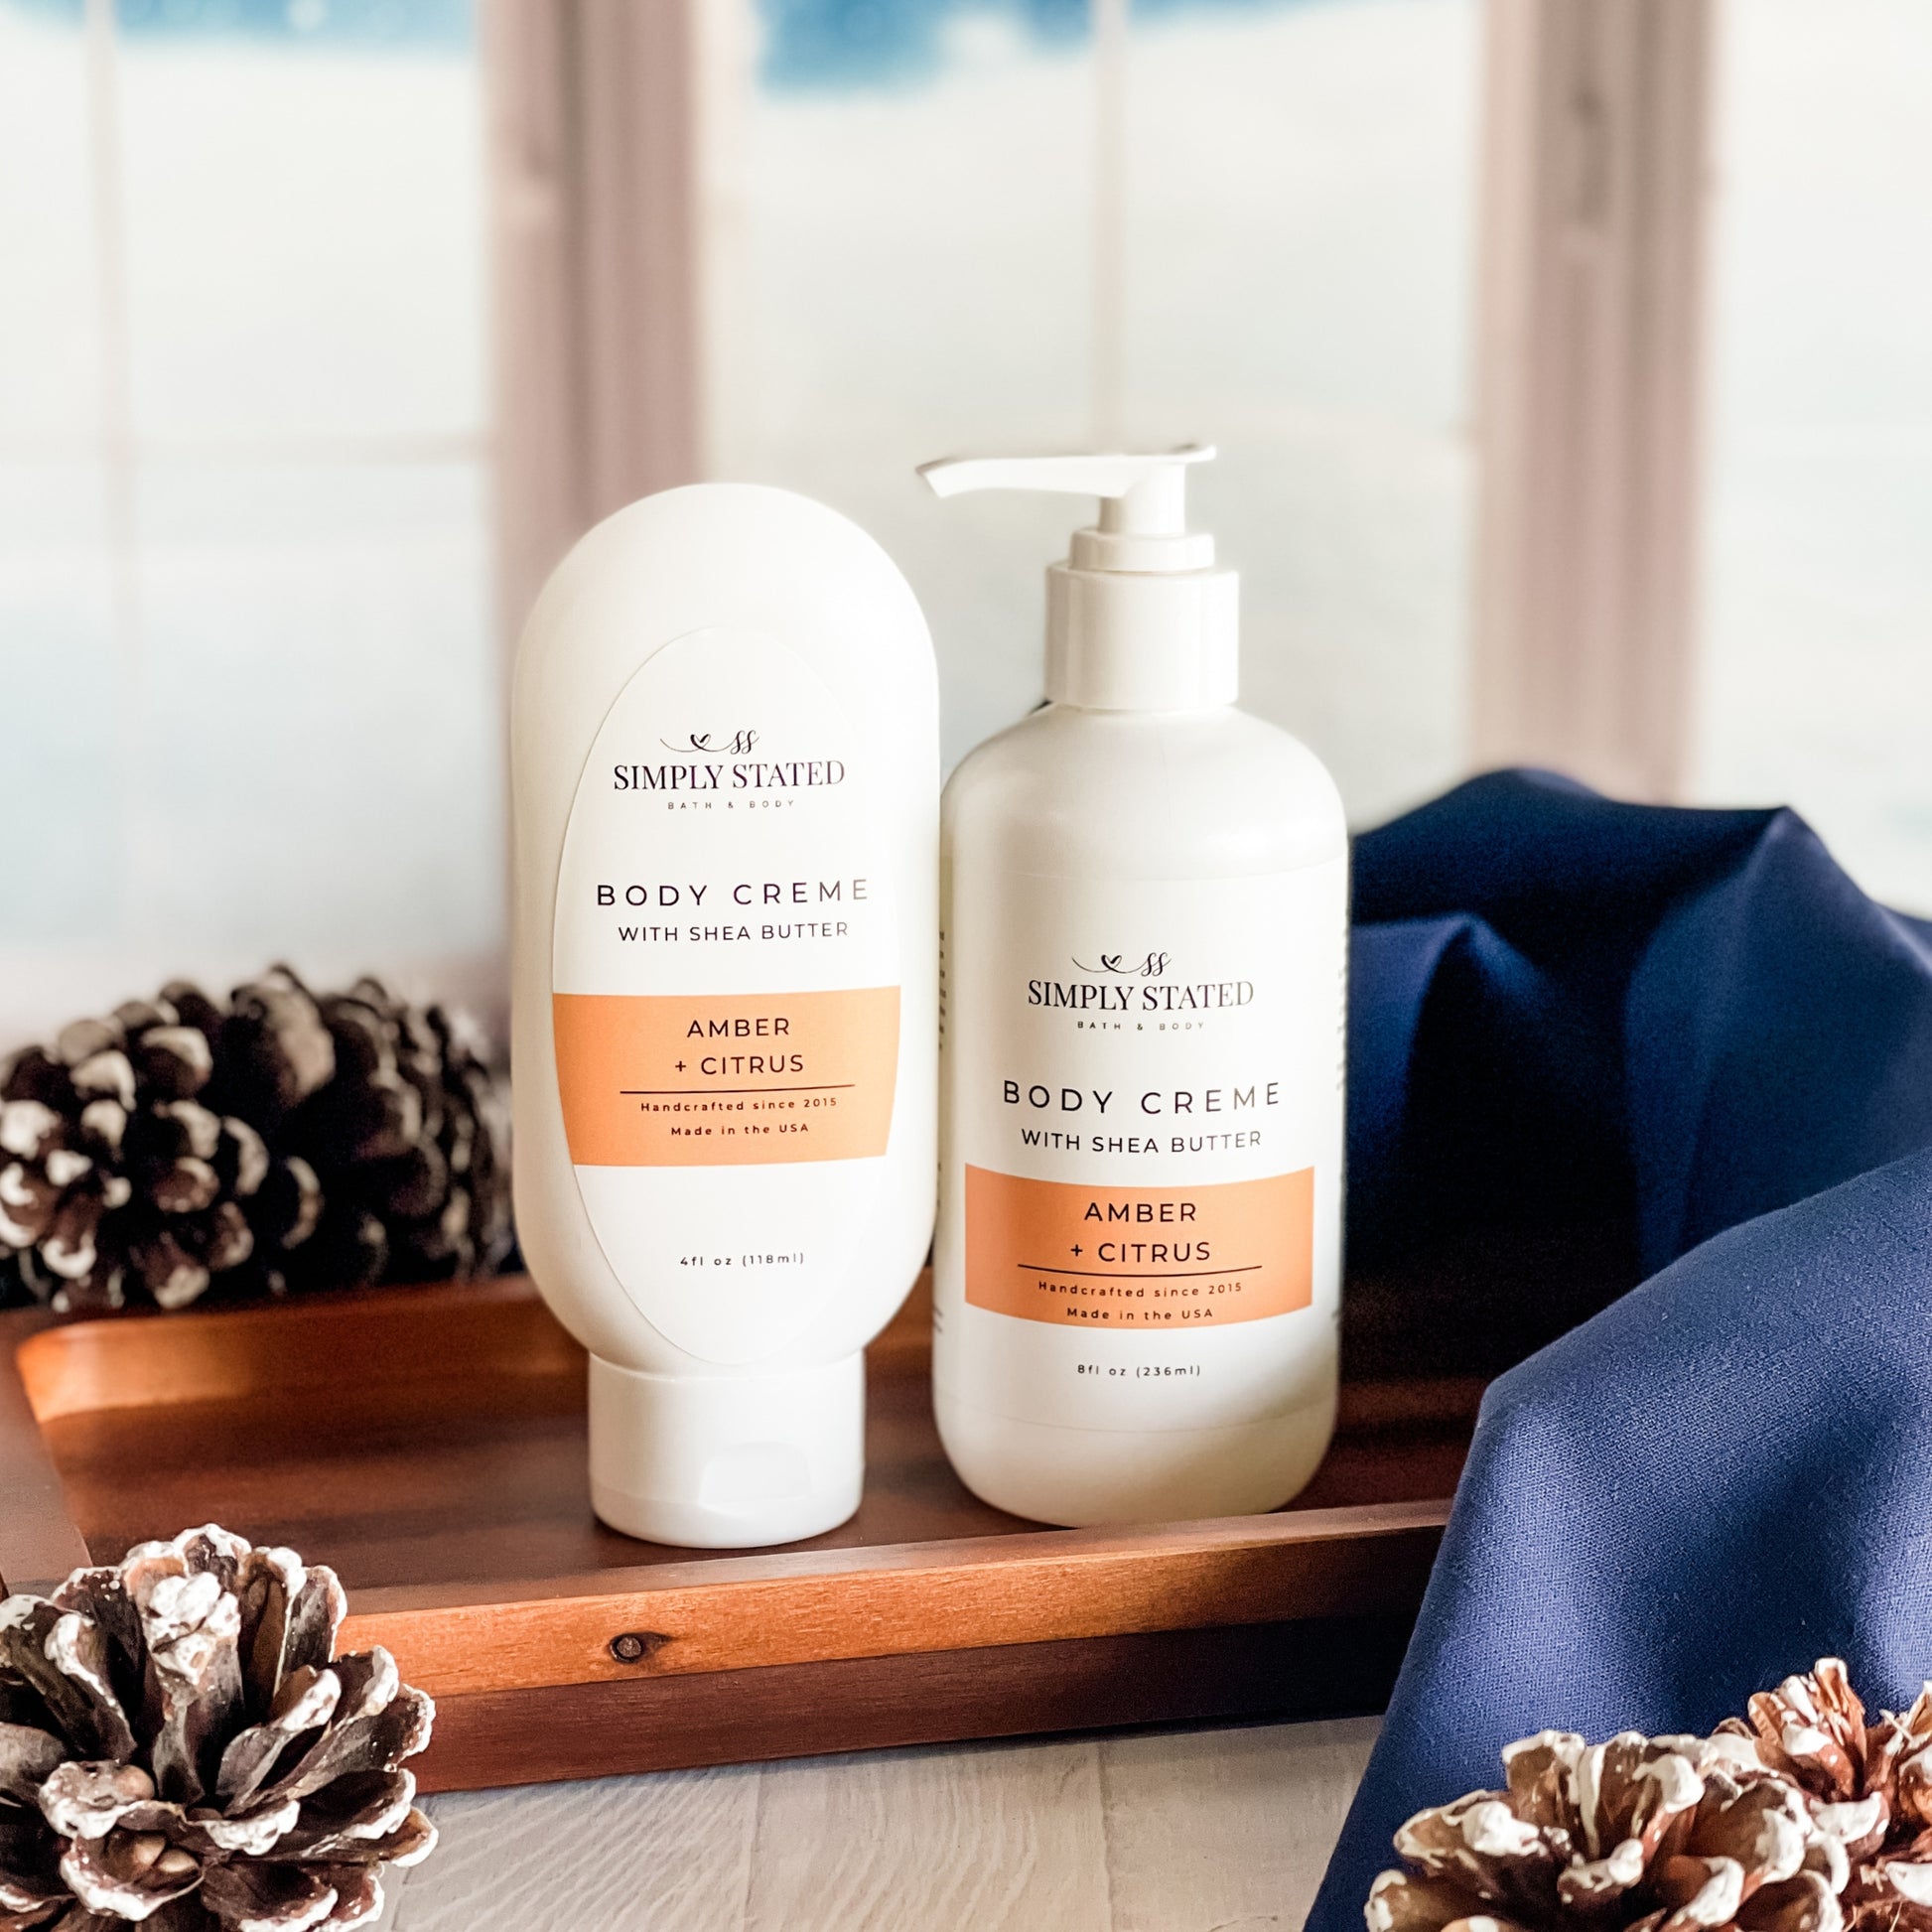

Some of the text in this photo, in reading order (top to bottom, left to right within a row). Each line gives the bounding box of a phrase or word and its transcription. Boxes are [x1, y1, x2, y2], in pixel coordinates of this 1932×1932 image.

[615, 761, 844, 790] SIMPLY STATED
[667, 799, 794, 811] BATH & BODY
[598, 880, 867, 906] BODY CREME
[618, 921, 848, 942] WITH SHEA BUTTER
[1029, 980, 1253, 1011] SIMPLY STATED
[687, 1018, 789, 1037] AMBER
[1076, 1020, 1204, 1033] BATH & BODY
[674, 1054, 803, 1075] + CITRUS
[640, 1096, 837, 1113] Handcrafted since 2015
[1004, 1080, 1278, 1114] BODY CREME
[670, 1122, 809, 1137] Made in the USA
[1022, 1128, 1261, 1154] WITH SHEA BUTTER
[1084, 1202, 1196, 1223] AMBER
[679, 1252, 804, 1268] 4fl oz (118ml)
[1068, 1241, 1210, 1263] + CITRUS
[1038, 1281, 1242, 1299] Handcrafted since 2015
[1066, 1306, 1213, 1321] Made in the USA
[1076, 1363, 1201, 1379] 8fl oz (236ml)
